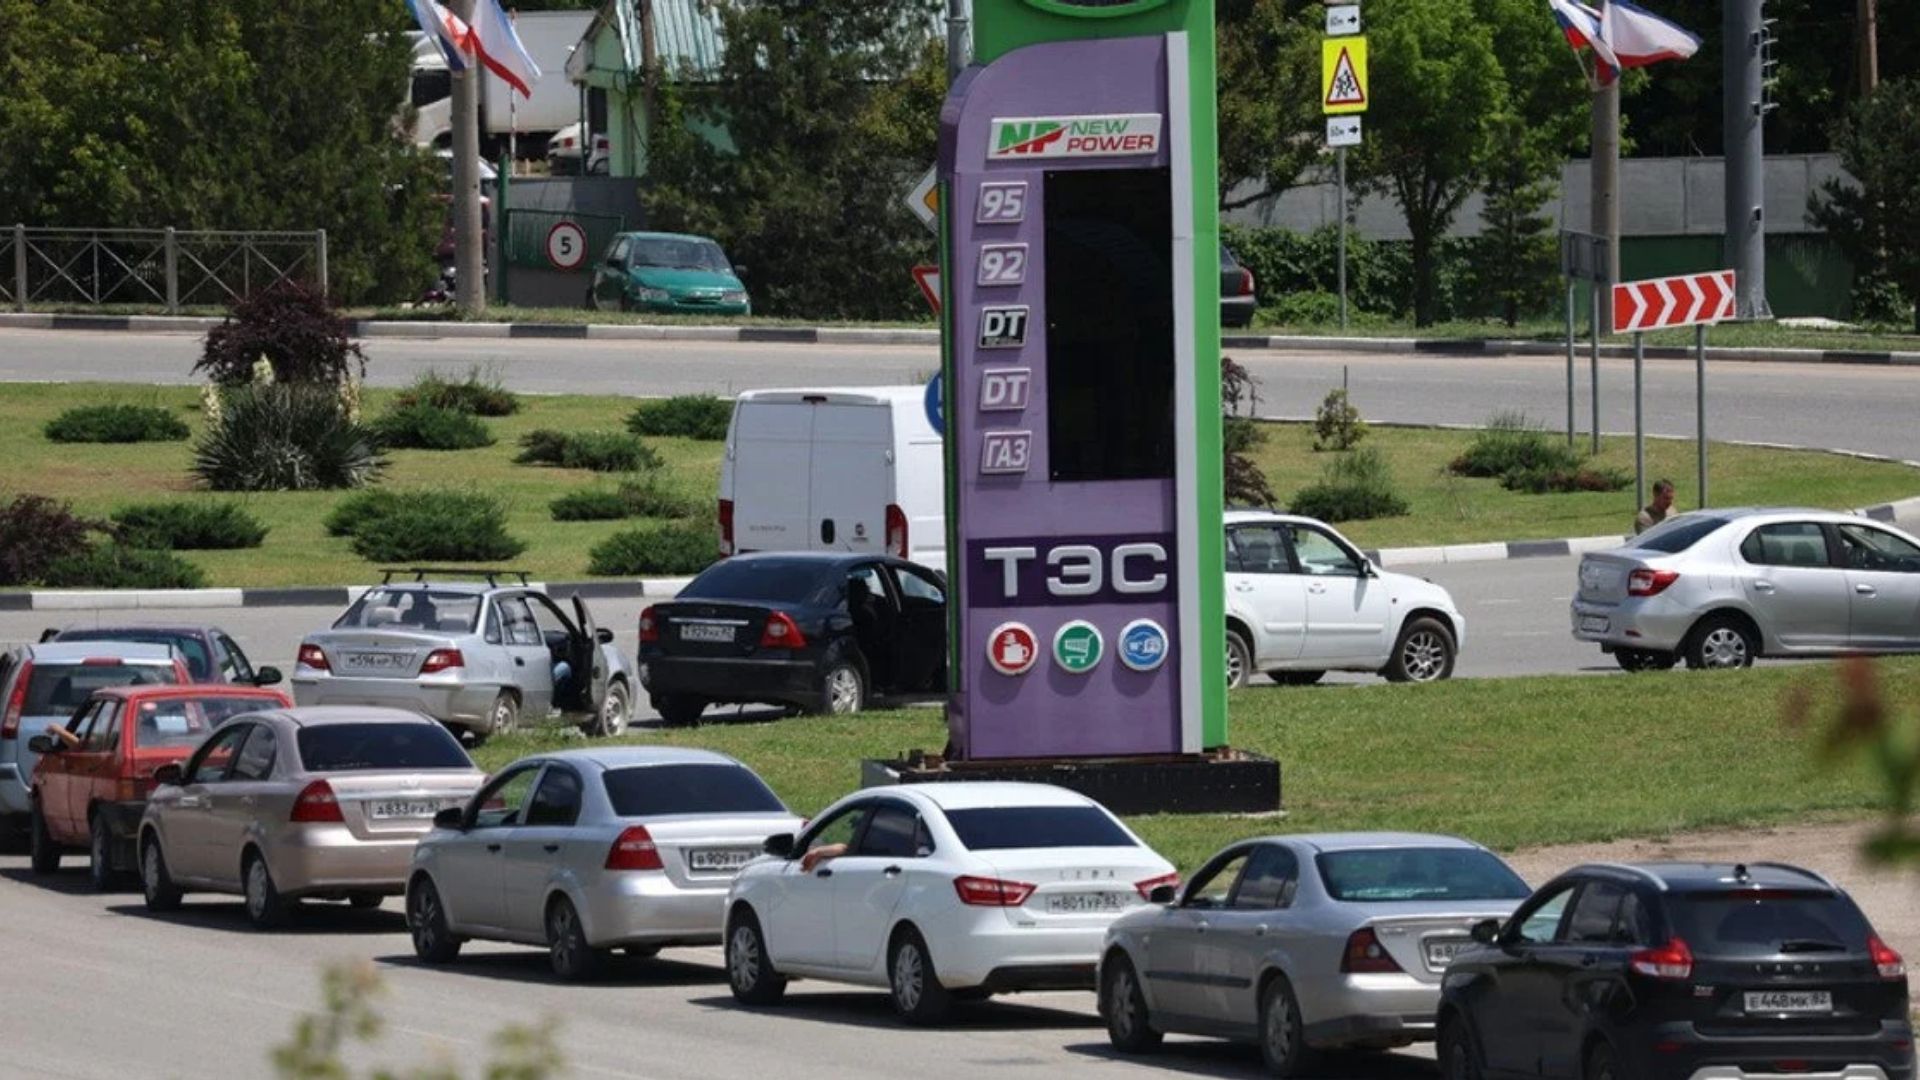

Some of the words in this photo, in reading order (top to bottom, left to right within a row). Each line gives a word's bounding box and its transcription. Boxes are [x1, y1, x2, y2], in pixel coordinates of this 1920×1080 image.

[996, 122, 1068, 154] NP
[1070, 119, 1129, 135] NEW
[1066, 135, 1155, 152] POWER
[983, 189, 1023, 217] 95
[560, 236, 572, 255] 5
[983, 250, 1024, 280] 92
[983, 311, 1026, 337] DT
[983, 374, 1027, 405] DT
[985, 438, 1027, 468] ГАЗ
[984, 543, 1168, 597] ТЭС
